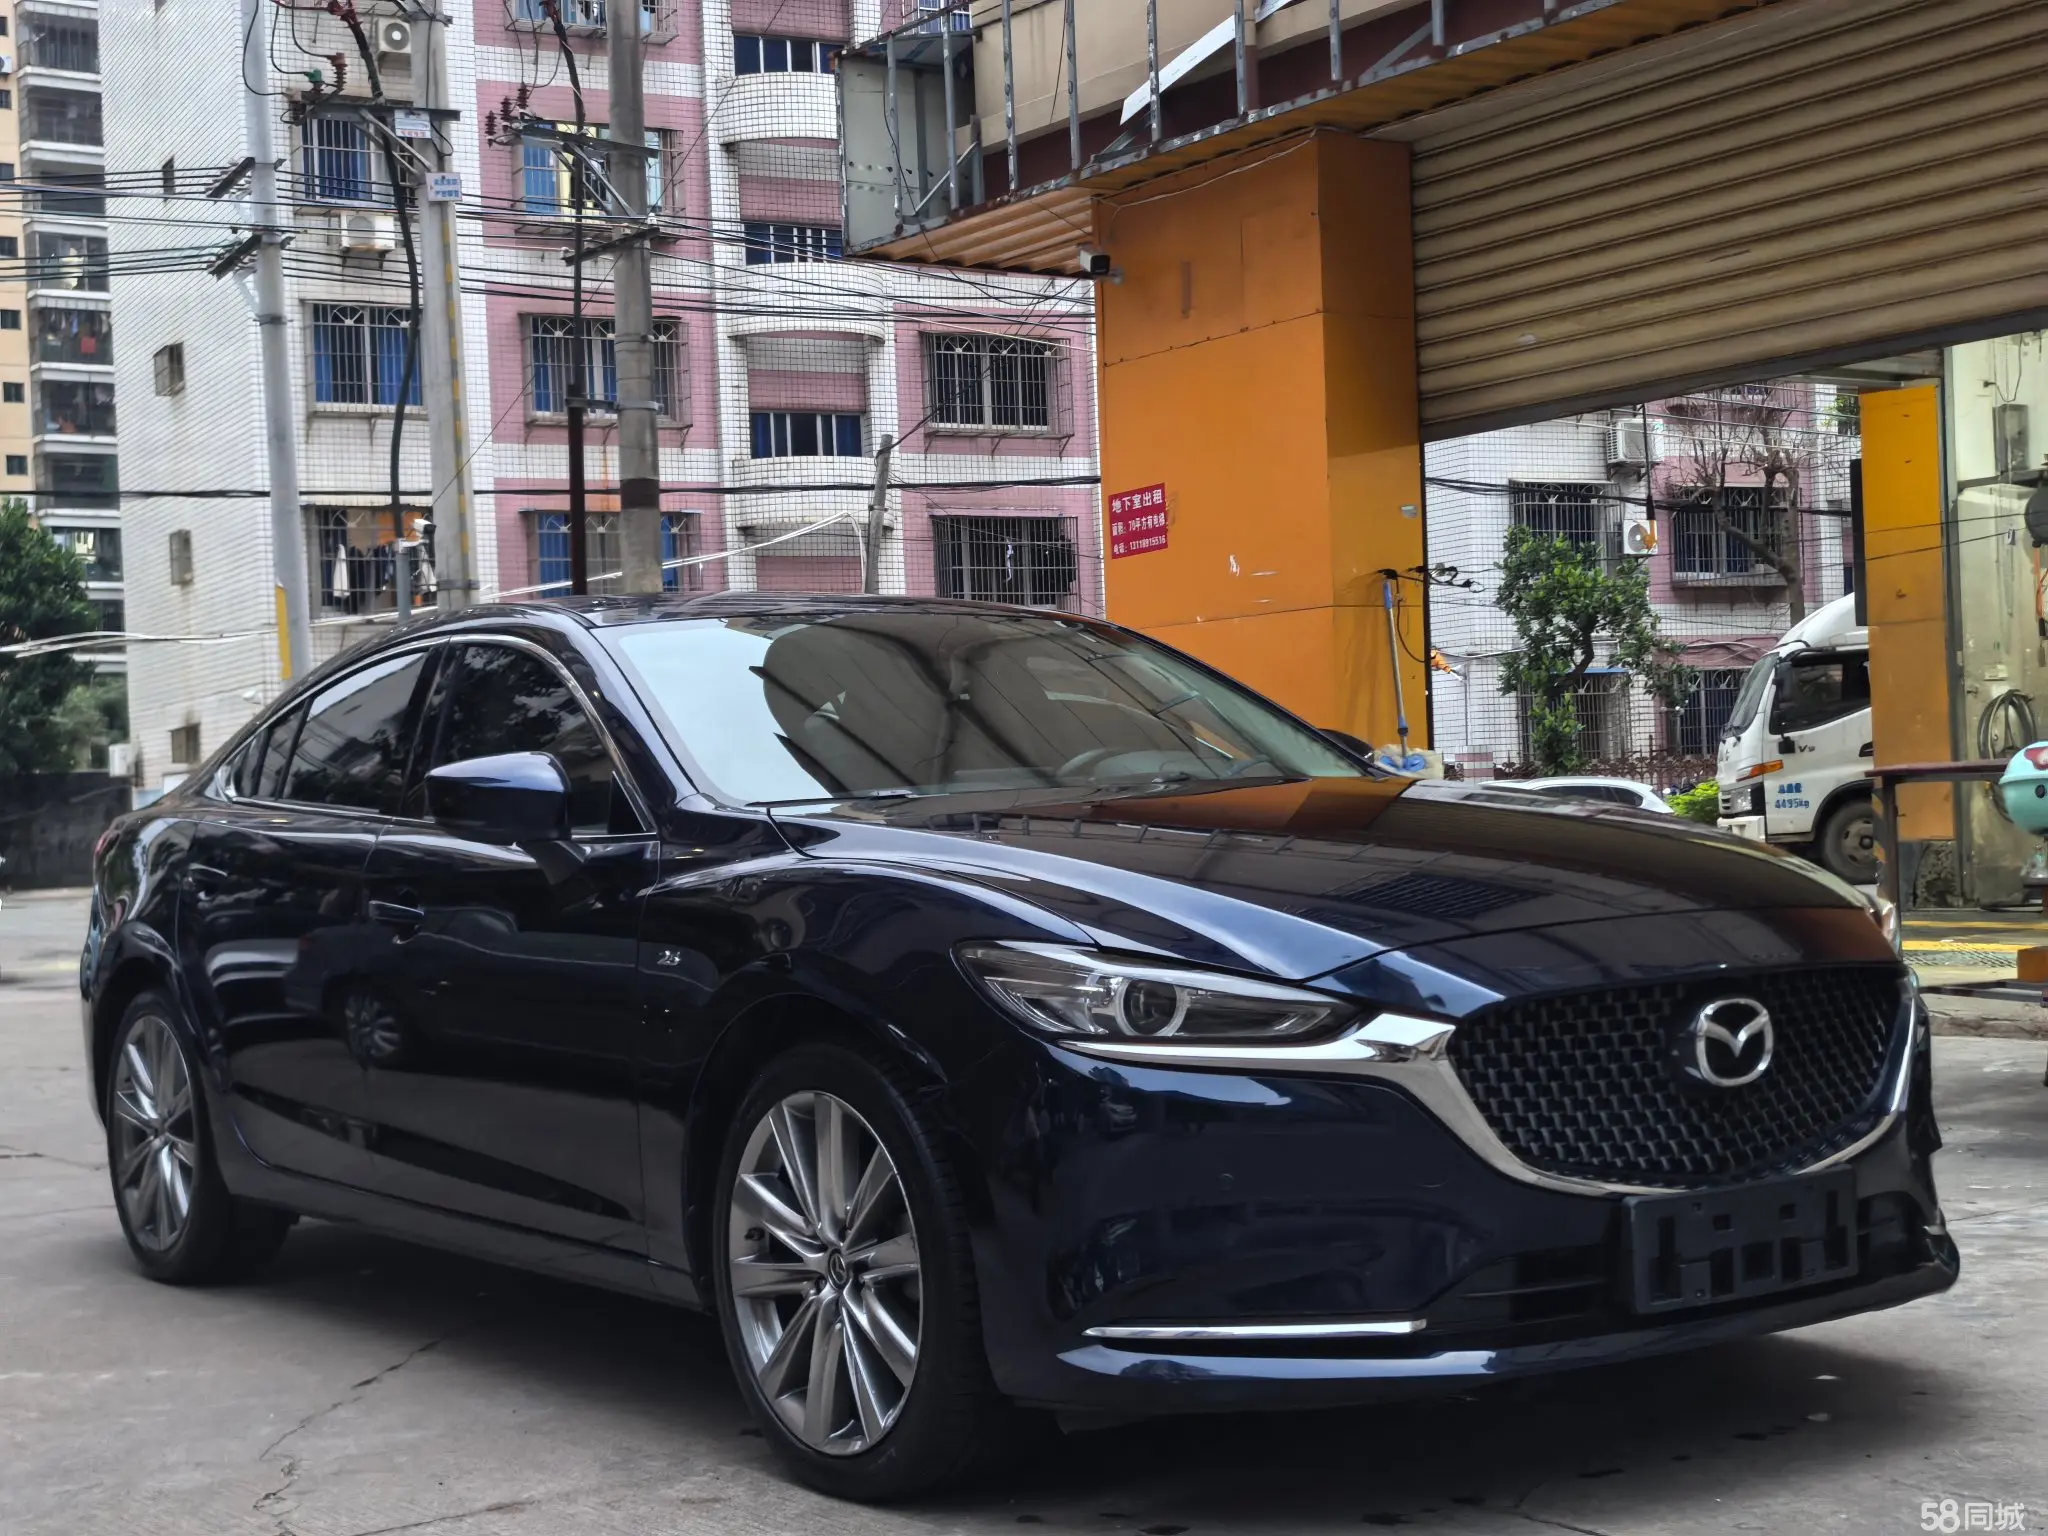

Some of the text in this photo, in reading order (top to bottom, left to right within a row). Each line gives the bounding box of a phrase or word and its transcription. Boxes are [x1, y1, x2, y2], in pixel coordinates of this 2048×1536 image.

[1112, 489, 1162, 513] 地下室出租
